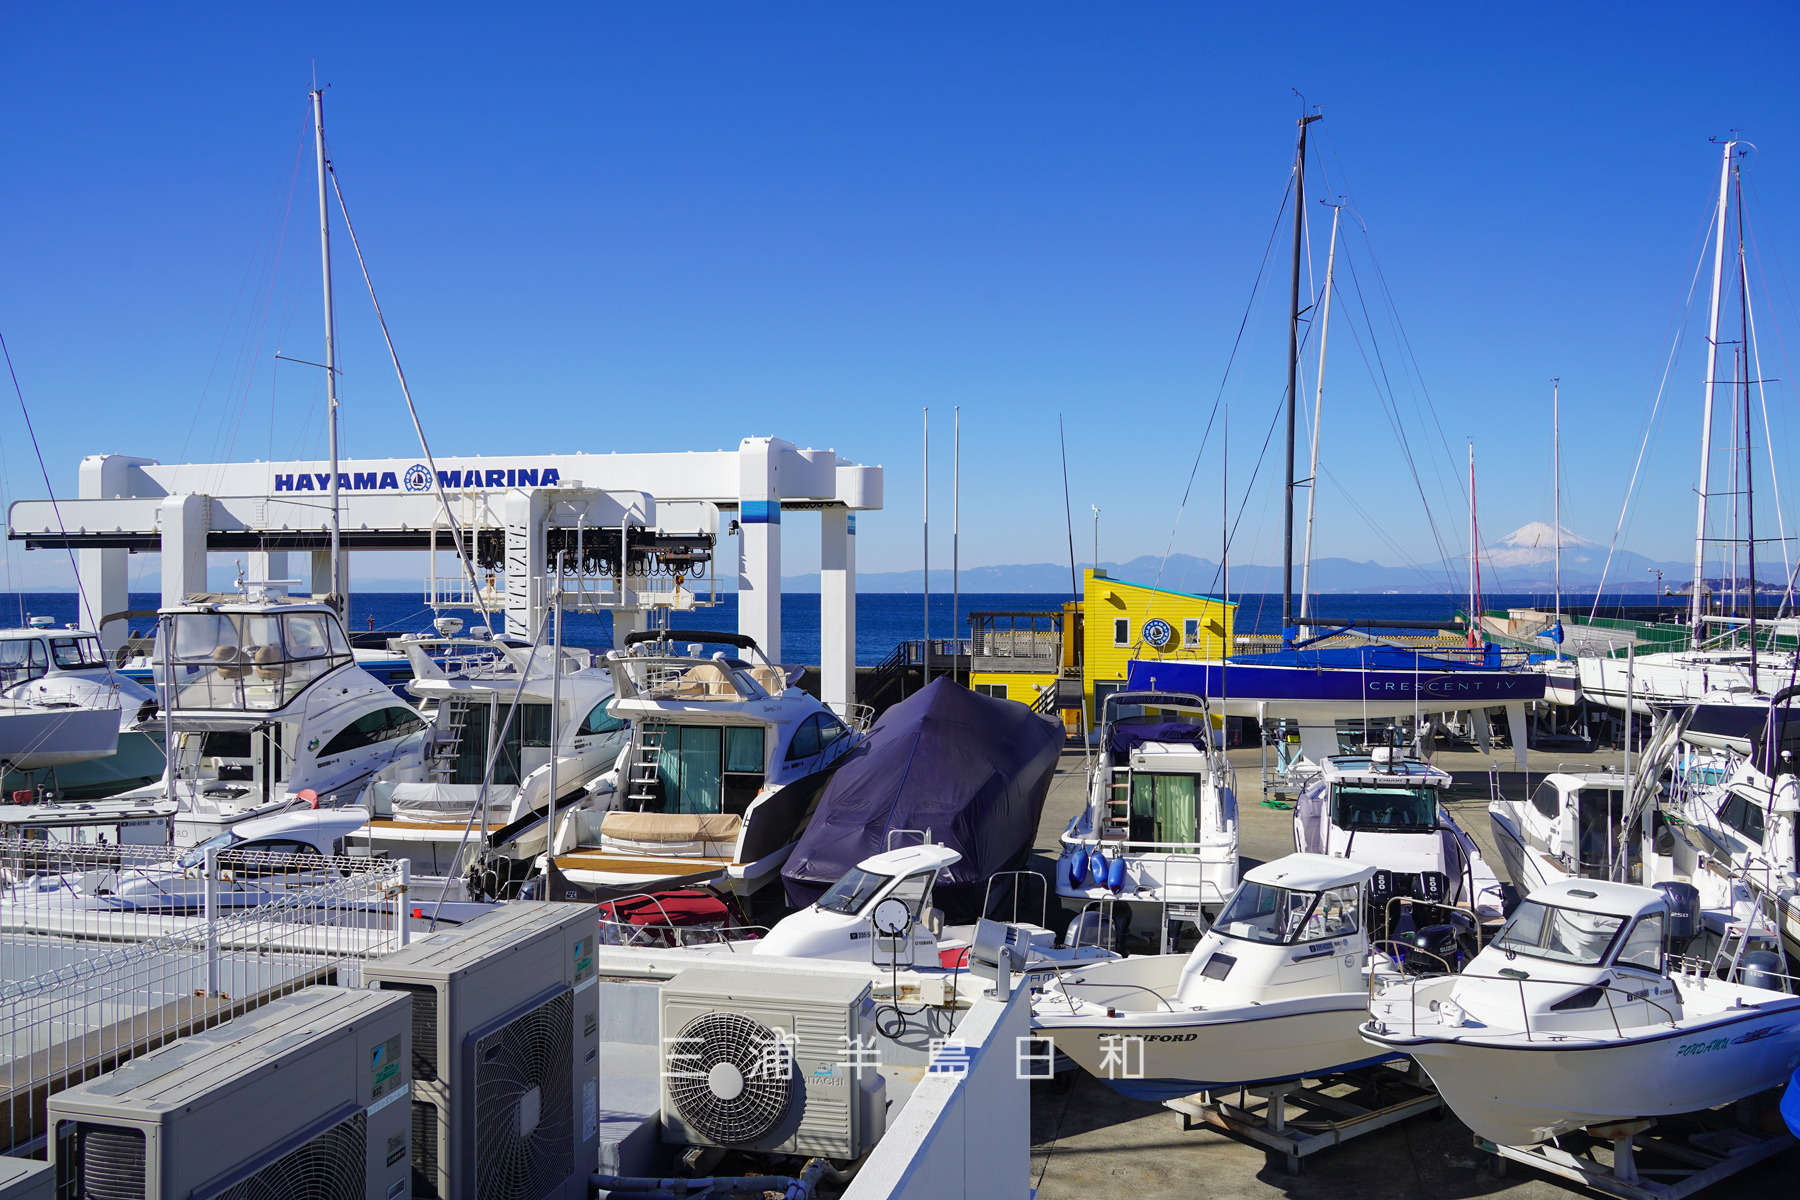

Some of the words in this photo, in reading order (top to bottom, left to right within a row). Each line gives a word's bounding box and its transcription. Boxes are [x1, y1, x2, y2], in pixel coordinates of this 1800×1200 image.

[275, 472, 399, 491] HAYAMA
[437, 468, 561, 488] MARINA
[509, 521, 527, 610] HAYAMA
[1369, 681, 1483, 691] CRESCENT
[1496, 681, 1516, 690] IV
[1378, 874, 1386, 890] 200
[1429, 876, 1437, 892] 200
